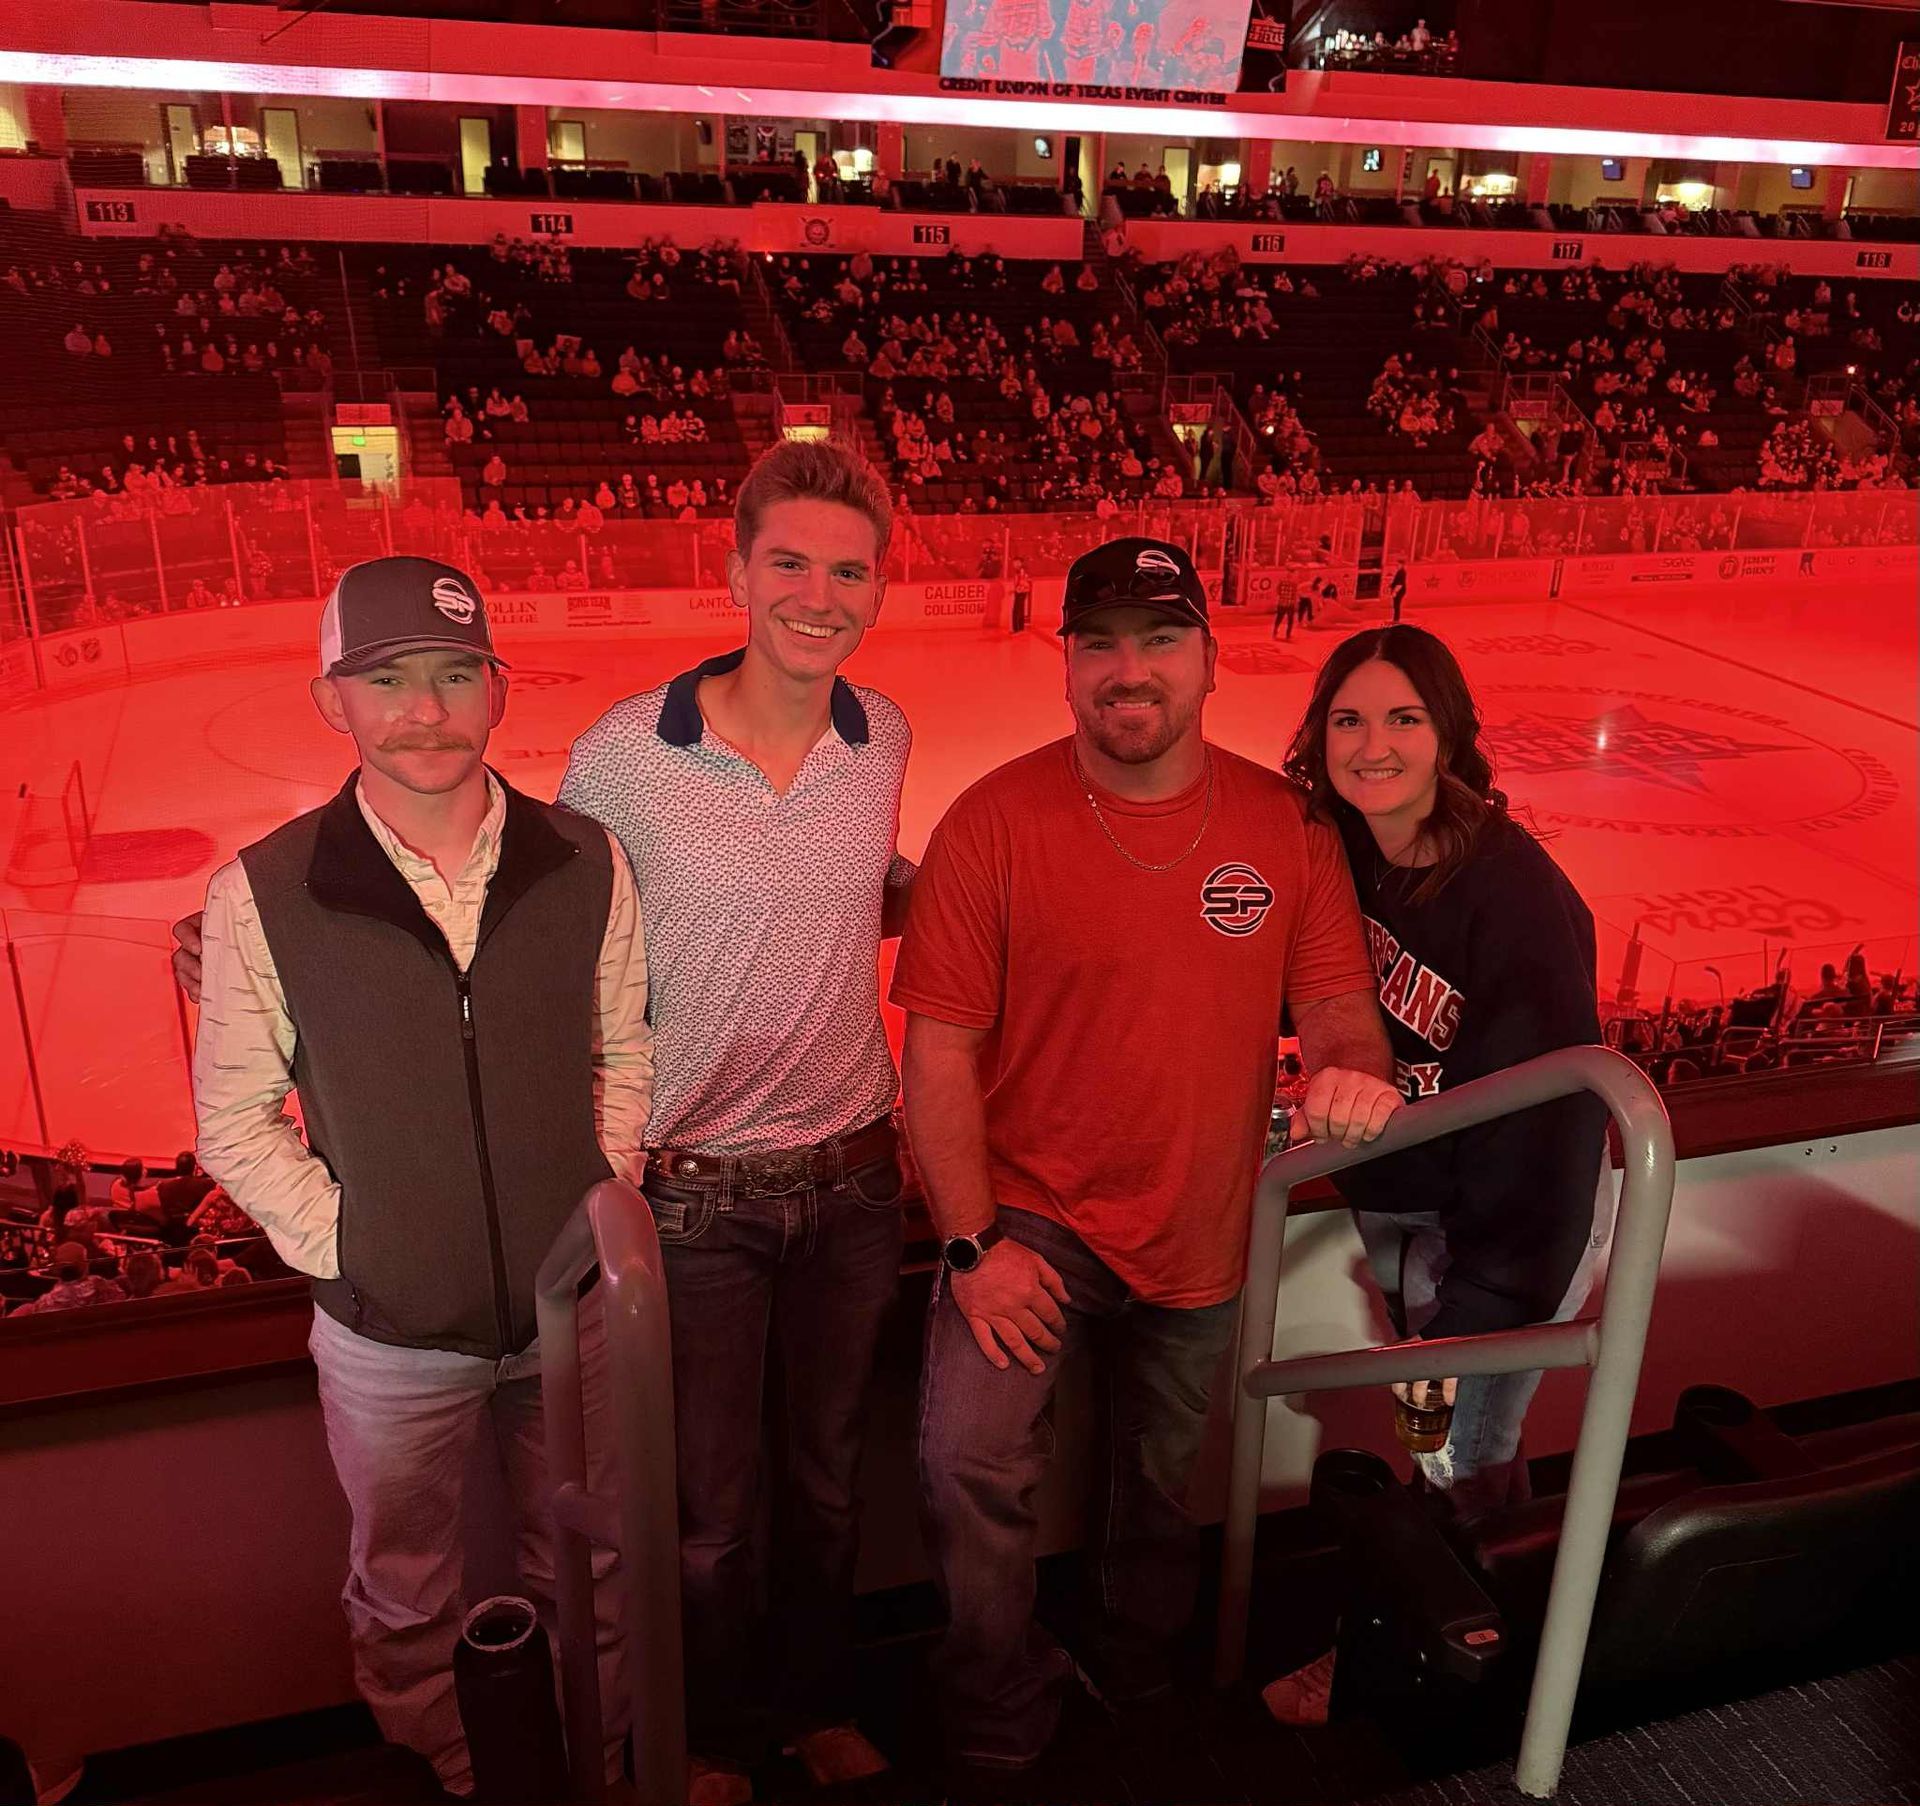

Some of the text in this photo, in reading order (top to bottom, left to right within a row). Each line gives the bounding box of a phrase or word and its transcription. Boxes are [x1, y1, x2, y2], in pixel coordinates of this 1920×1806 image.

[939, 78, 1227, 105] CREDIT UNION OF TEXAS EVENT CENTER
[95, 202, 128, 221] 113
[538, 216, 566, 232] 114
[920, 227, 944, 244] 115
[1258, 235, 1280, 252] 116
[1558, 243, 1579, 258] 117
[1863, 253, 1886, 267] 118
[924, 585, 985, 600] CALIBER
[485, 601, 537, 613] OLLIN
[924, 603, 985, 616] COLLISION
[490, 615, 540, 624] LLEGE
[1200, 884, 1275, 917] SP
[1634, 884, 1789, 912] LIGHT
[1640, 898, 1866, 937] Coors
[1395, 1059, 1443, 1097] EY
